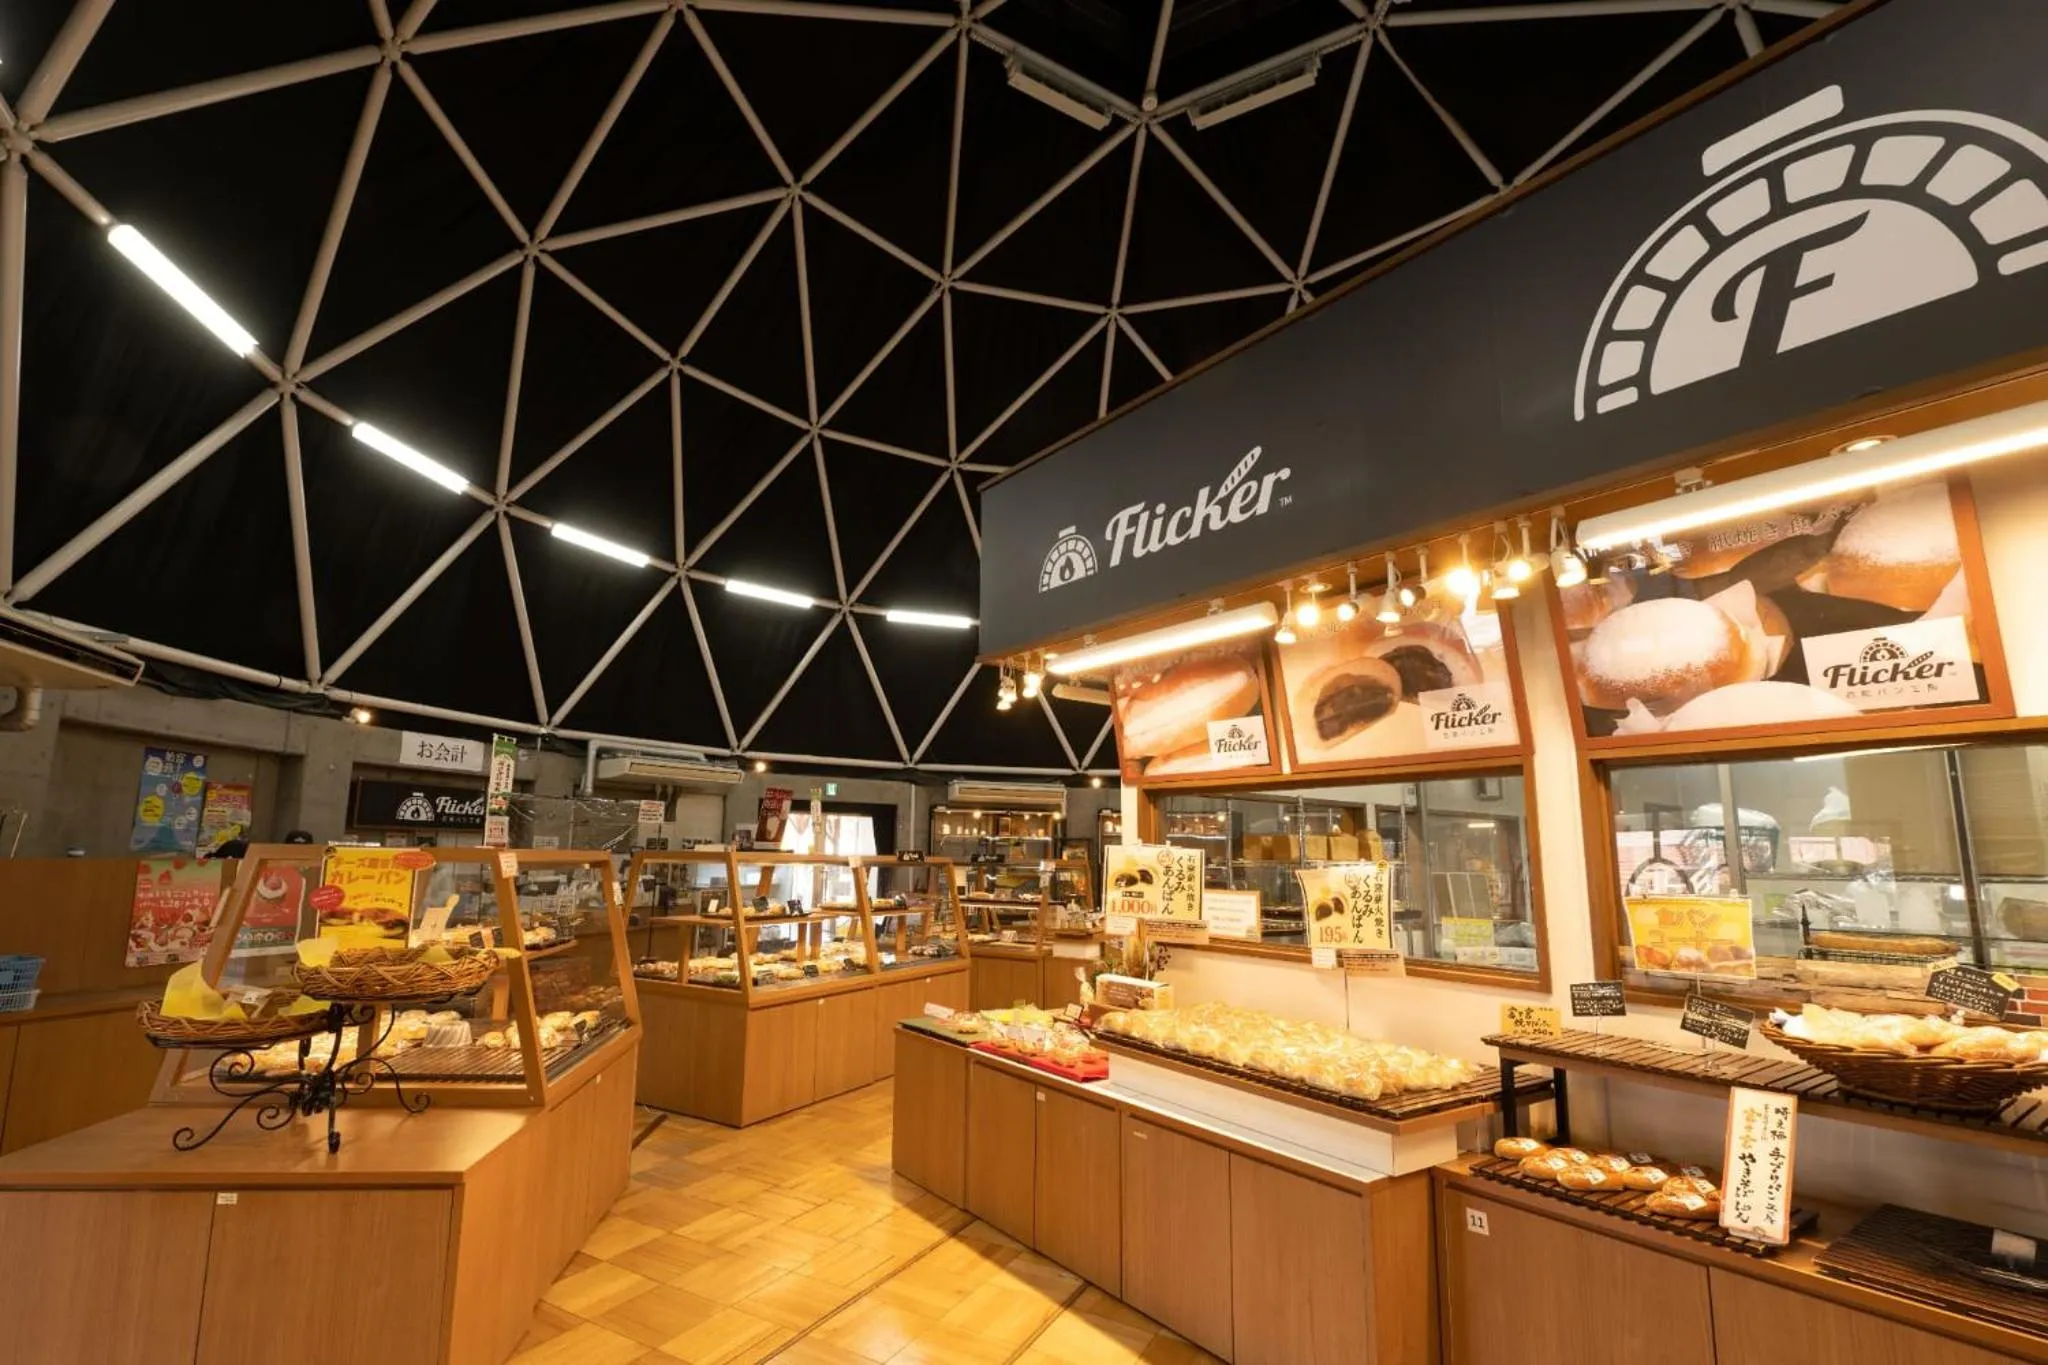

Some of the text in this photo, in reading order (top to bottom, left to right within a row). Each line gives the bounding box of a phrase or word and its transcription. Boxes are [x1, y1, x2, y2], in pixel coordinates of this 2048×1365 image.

[1105, 446, 1291, 568] Flicker
[1822, 651, 1955, 689] Flicker
[1430, 704, 1502, 731] Flicker
[416, 740, 468, 763] お会計
[1214, 734, 1262, 753] Flicker
[331, 870, 407, 886] カレーパン
[1175, 855, 1186, 894] くるみ
[1362, 874, 1374, 918] くるみ
[1469, 1214, 1486, 1229] 11
